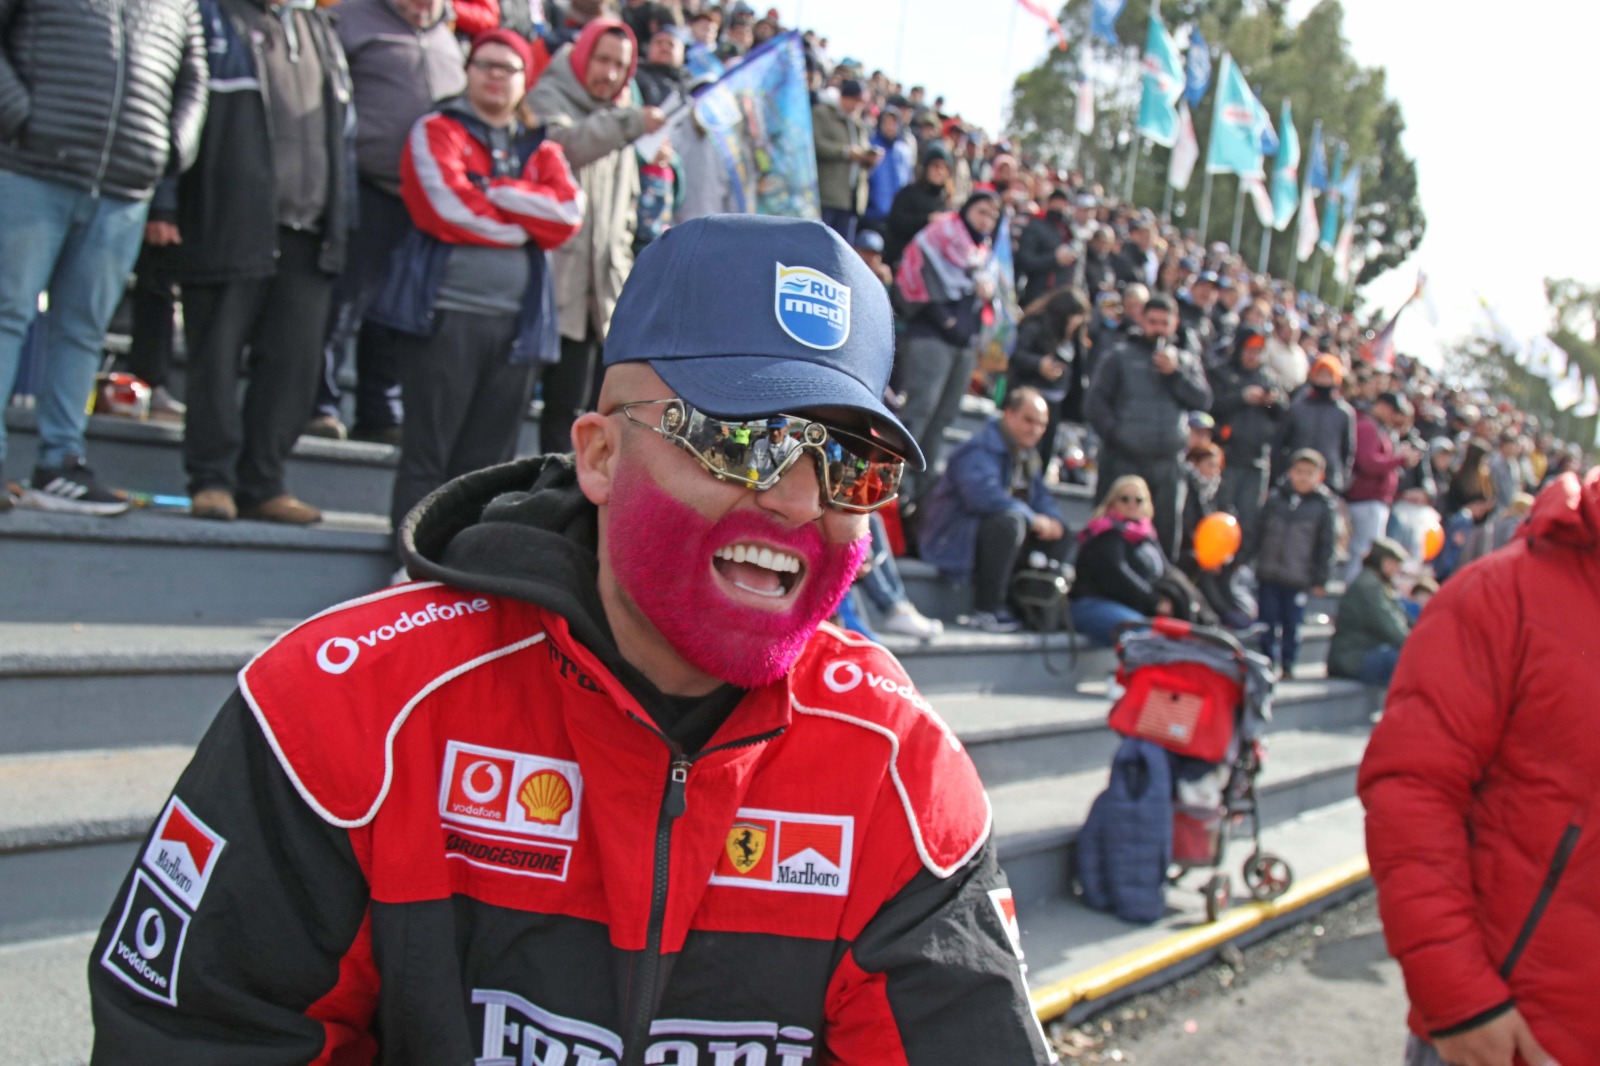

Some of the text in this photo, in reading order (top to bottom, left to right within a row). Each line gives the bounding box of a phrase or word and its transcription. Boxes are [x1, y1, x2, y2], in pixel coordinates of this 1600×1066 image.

[785, 298, 844, 324] med
[810, 280, 847, 306] RUS
[356, 597, 491, 647] vodafone
[865, 672, 961, 752] voda
[452, 803, 502, 819] vodafone
[154, 848, 193, 893] Marlboro
[445, 833, 564, 872] BRIDGESTONE
[776, 862, 840, 887] Marlboro
[117, 940, 168, 989] vodafone
[471, 988, 815, 1066] Ferari
